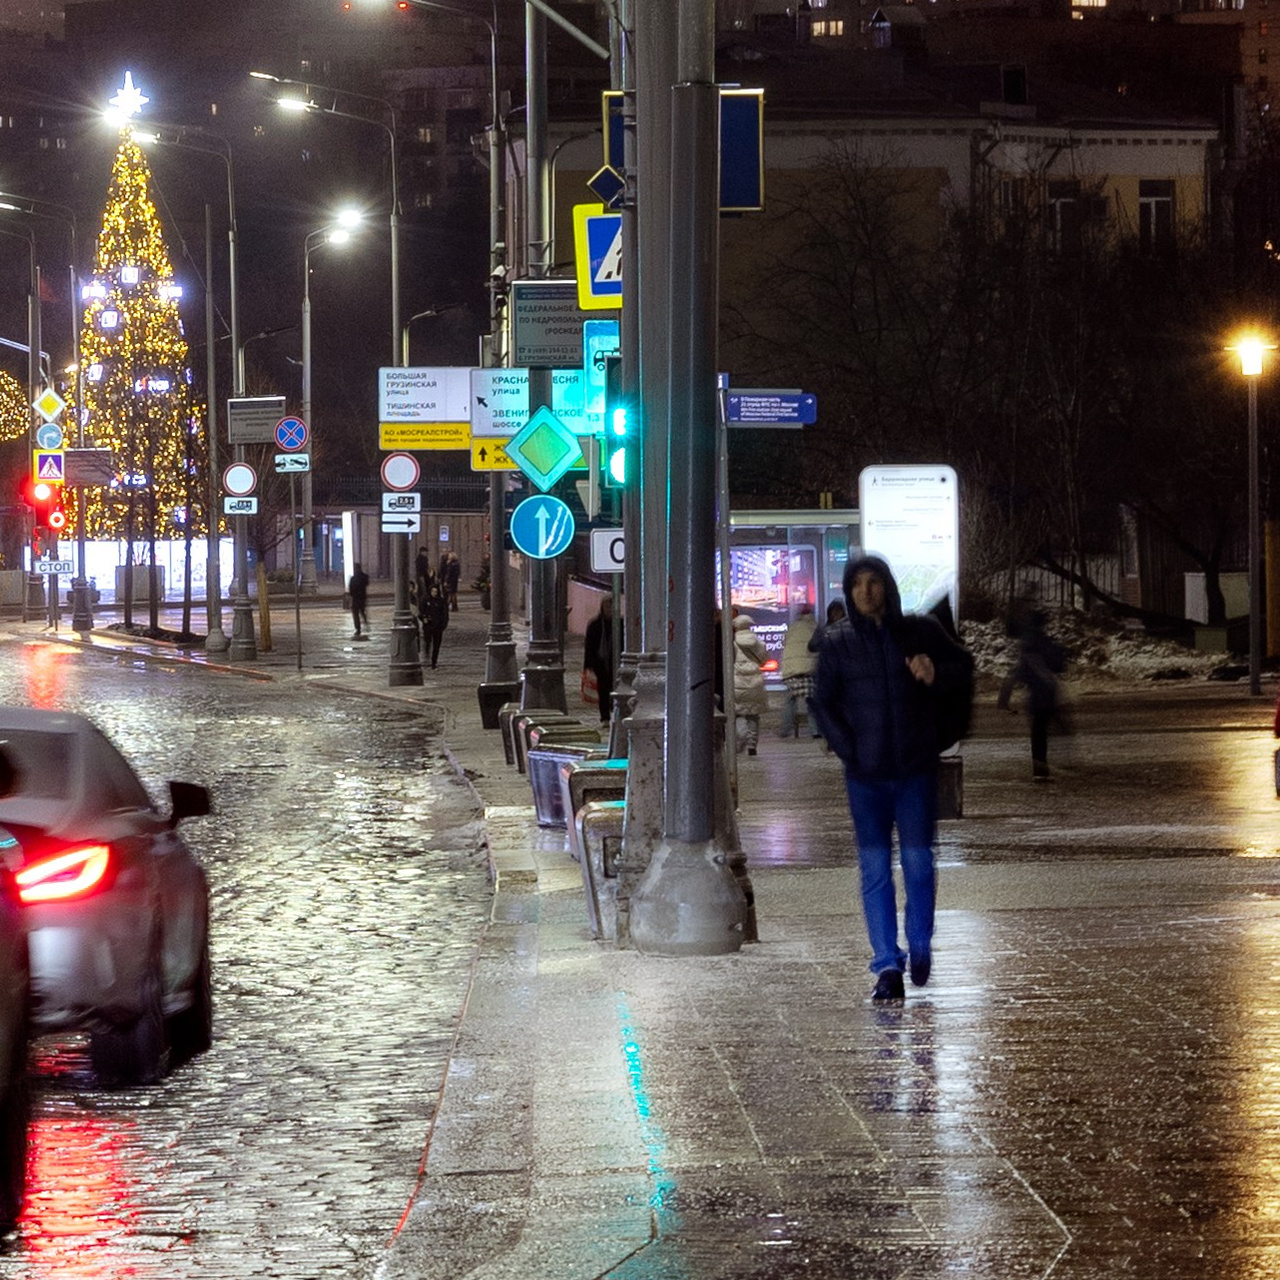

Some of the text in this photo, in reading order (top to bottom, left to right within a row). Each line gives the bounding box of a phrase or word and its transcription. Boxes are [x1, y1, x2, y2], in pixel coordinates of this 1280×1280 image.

[492, 376, 579, 384] КРАСНА ЕСНЯ
[39, 563, 71, 572] СТОП
[765, 640, 785, 652] руб.
